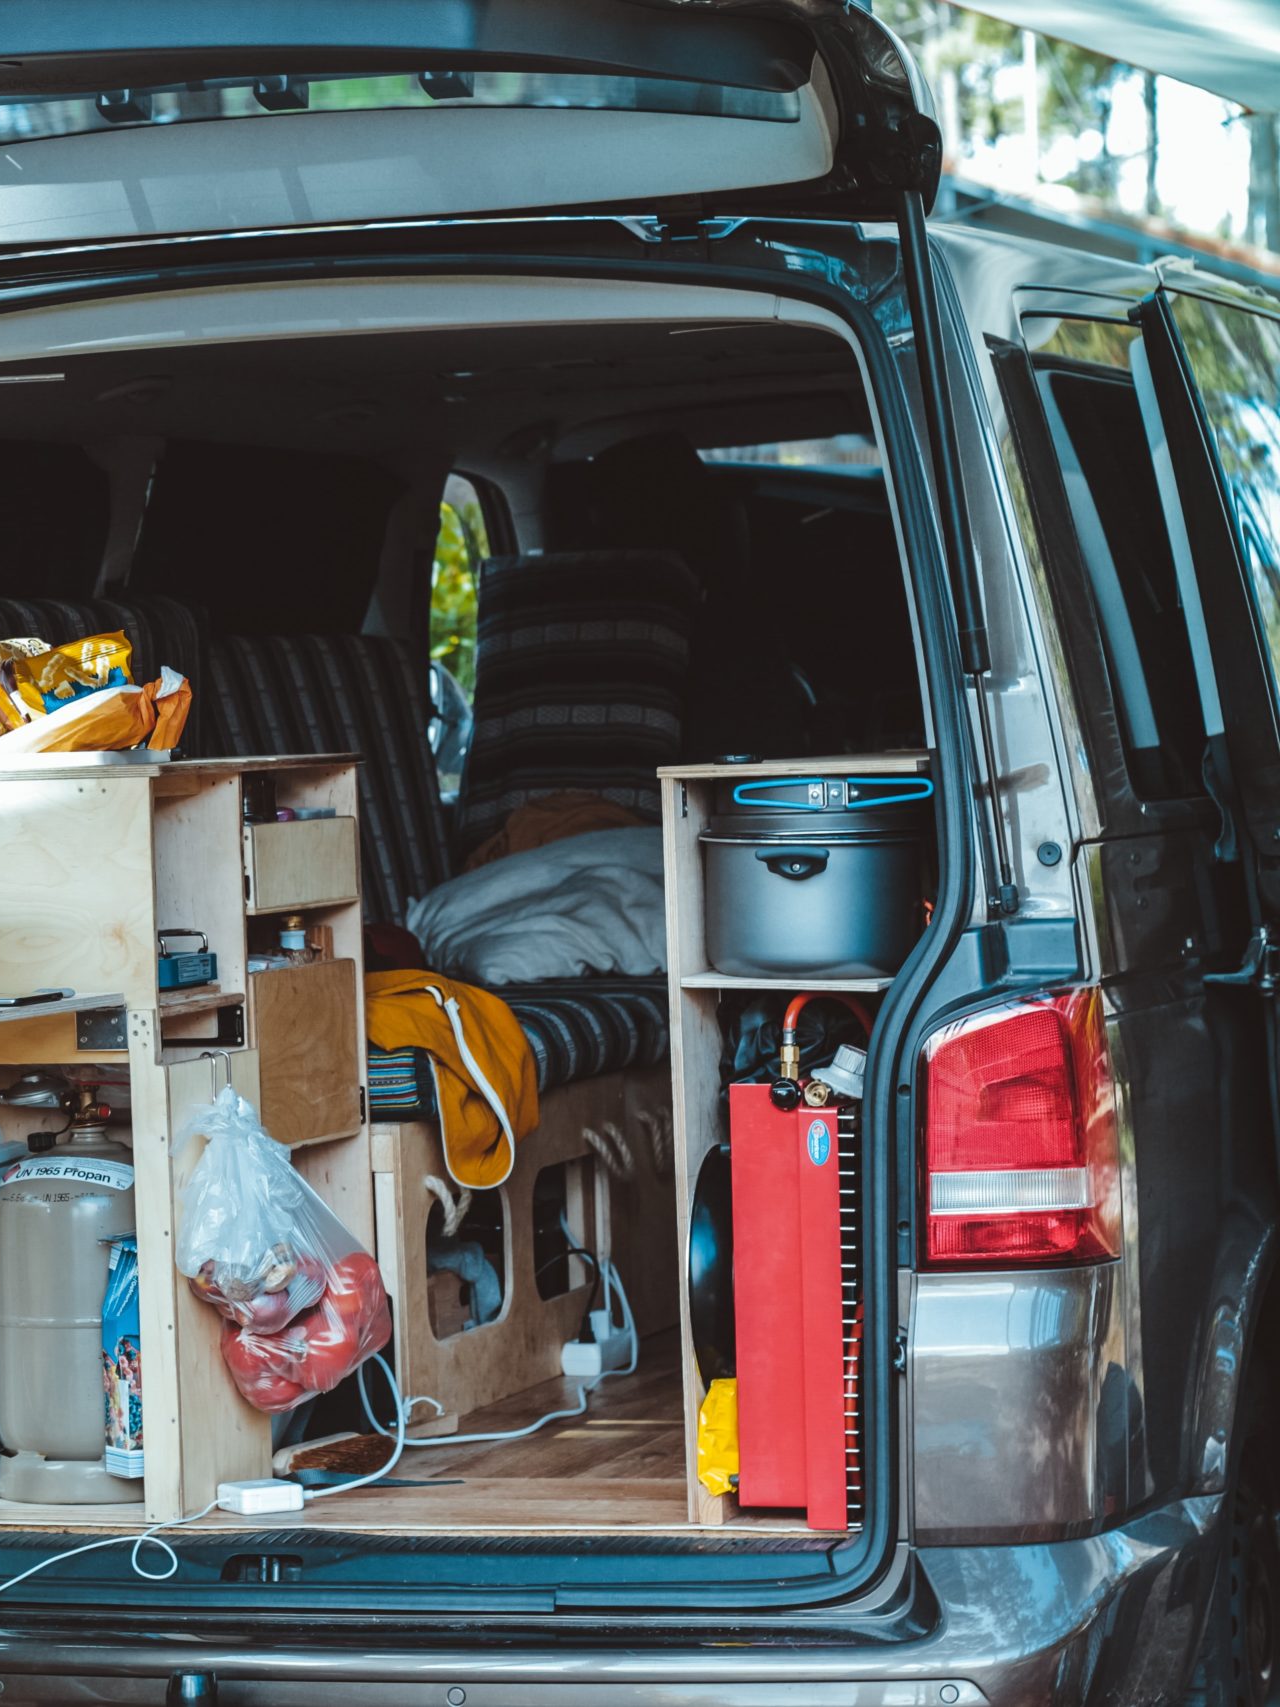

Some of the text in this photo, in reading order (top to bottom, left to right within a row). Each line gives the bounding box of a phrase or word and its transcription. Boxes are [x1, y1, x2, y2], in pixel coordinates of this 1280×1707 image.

[15, 1167, 33, 1179] UN
[35, 1167, 61, 1176] 1965
[63, 1167, 111, 1183] Propan
[53, 1193, 71, 1203] 1965
